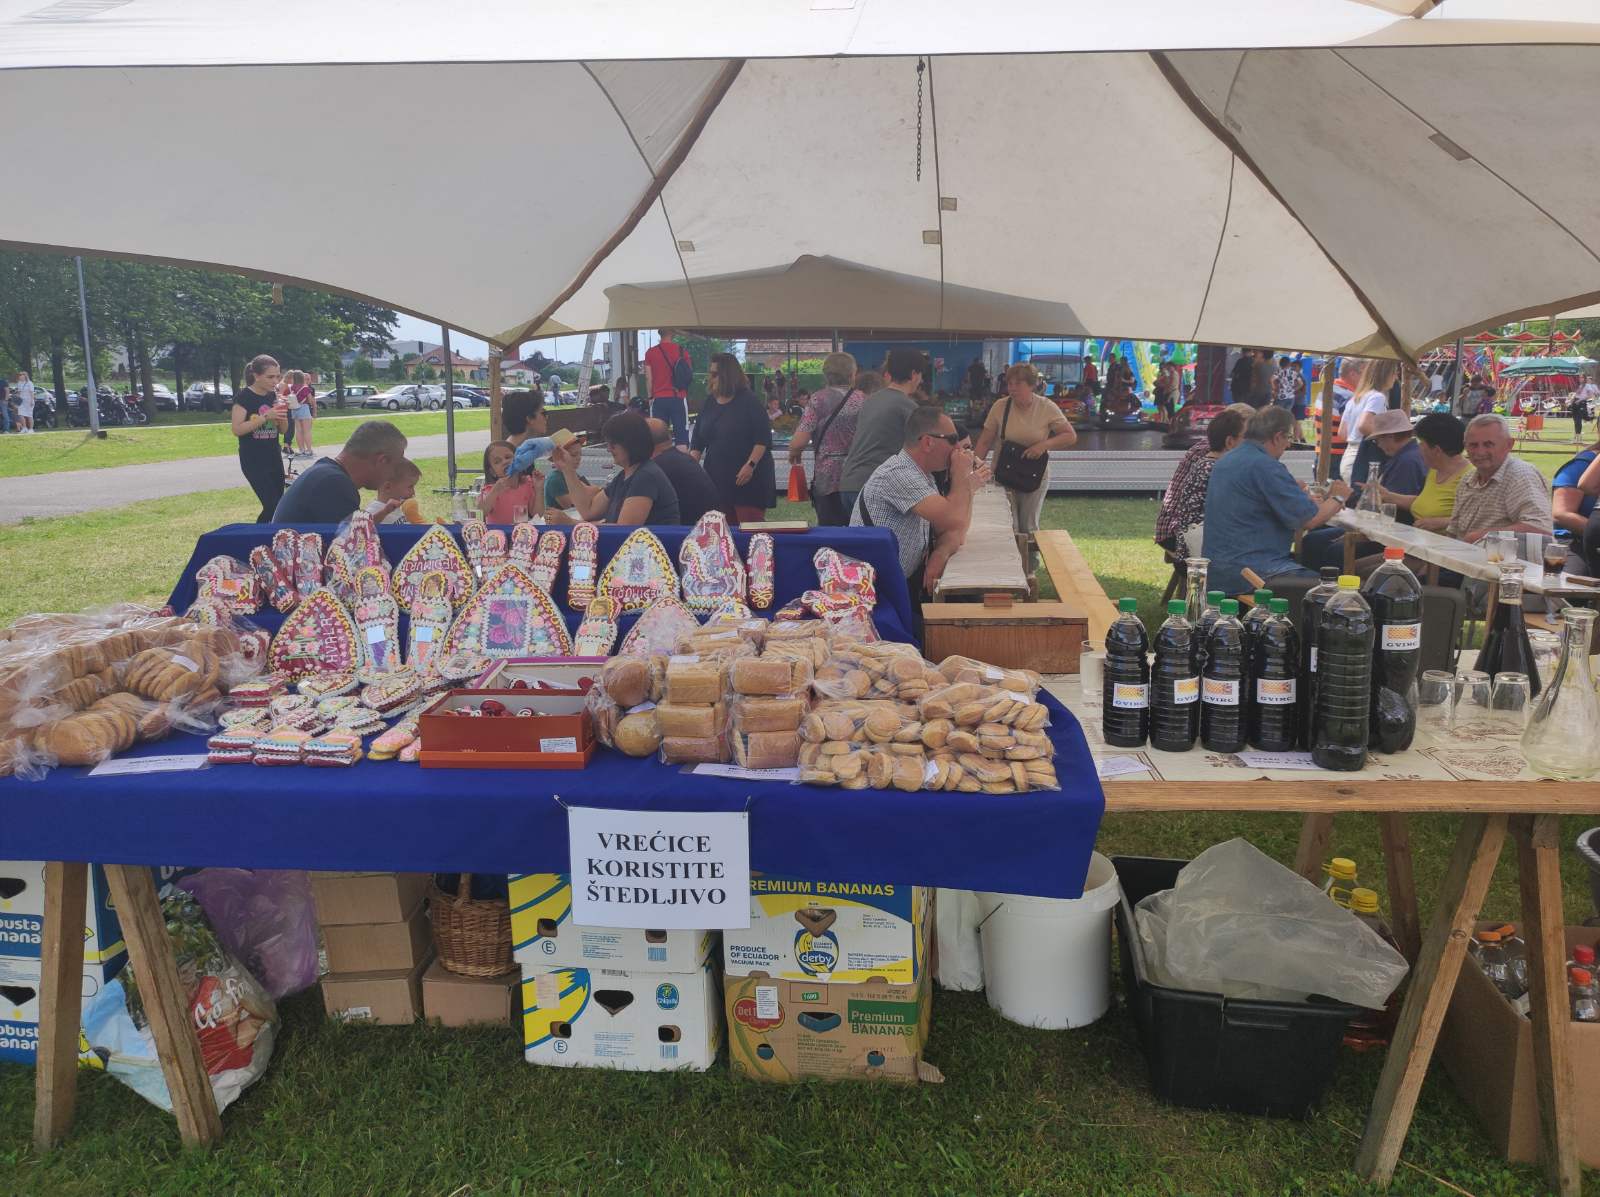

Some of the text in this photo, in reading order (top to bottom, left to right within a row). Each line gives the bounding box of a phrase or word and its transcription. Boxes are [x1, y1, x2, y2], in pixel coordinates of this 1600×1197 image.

[597, 830, 712, 853] VREĆICE
[587, 857, 725, 879] KORISTITE
[587, 880, 727, 905] ŠTEDLJIVO
[816, 882, 895, 896] BANANAS
[730, 945, 767, 953] PRODUCE
[742, 952, 780, 961] ECUADOR
[801, 952, 832, 969] derby
[851, 1010, 905, 1023] Premium
[851, 1022, 913, 1036] BANANAS
